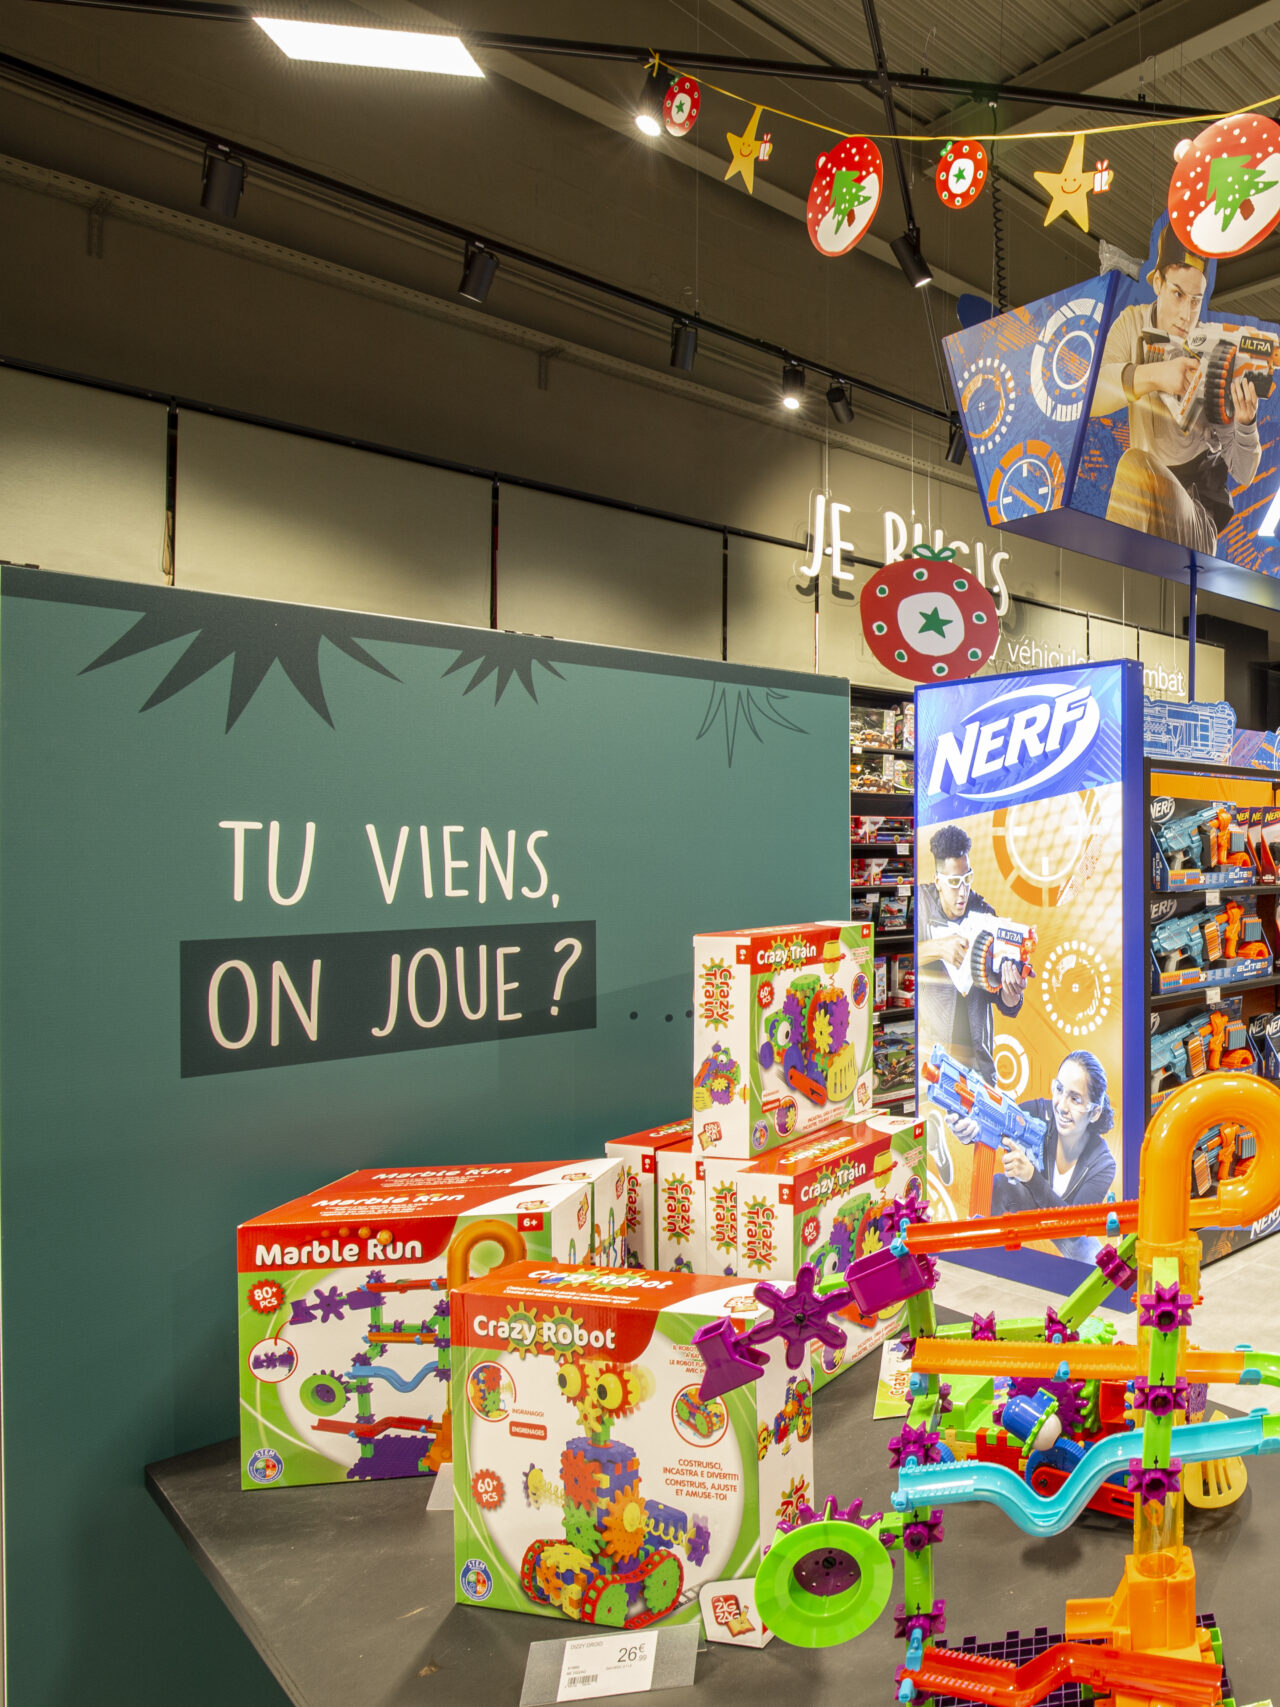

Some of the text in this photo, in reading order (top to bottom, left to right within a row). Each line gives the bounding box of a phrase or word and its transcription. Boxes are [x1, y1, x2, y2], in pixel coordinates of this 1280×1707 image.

[1241, 338, 1272, 352] ULTRA
[800, 494, 855, 581] JE
[927, 685, 1092, 797] NERF
[1150, 801, 1174, 820] NERF
[1236, 812, 1250, 822] NER
[1251, 811, 1263, 822] NE
[219, 820, 562, 909] TU VIENS,
[757, 944, 817, 965] Crazy Train
[207, 958, 323, 1050] ON
[371, 944, 524, 1037] JOUE
[704, 968, 718, 1020] Train
[719, 968, 732, 1023] Crazy
[800, 1162, 867, 1202] Crazy Train
[626, 1174, 640, 1227] Crazy
[666, 1183, 680, 1233] Train
[680, 1183, 693, 1236] Crazy
[522, 1217, 538, 1228] 6+
[715, 1191, 728, 1244] Train
[747, 1207, 761, 1260] Train
[763, 1206, 775, 1264] Crazy
[255, 1240, 423, 1267] Marble Run
[253, 1285, 278, 1302] 80+
[594, 1274, 674, 1290] Robot
[259, 1297, 278, 1309] PCS
[473, 1315, 616, 1350] Crazy Robot
[662, 1466, 699, 1478] INCASTRA
[476, 1478, 499, 1493] 60+
[482, 1491, 499, 1503] PCS
[665, 1478, 738, 1493] CONSTRUIS, AJUSTE
[675, 1488, 728, 1501] ET AMUSE-TOI
[617, 1646, 638, 1663] 26
[638, 1642, 646, 1653] €
